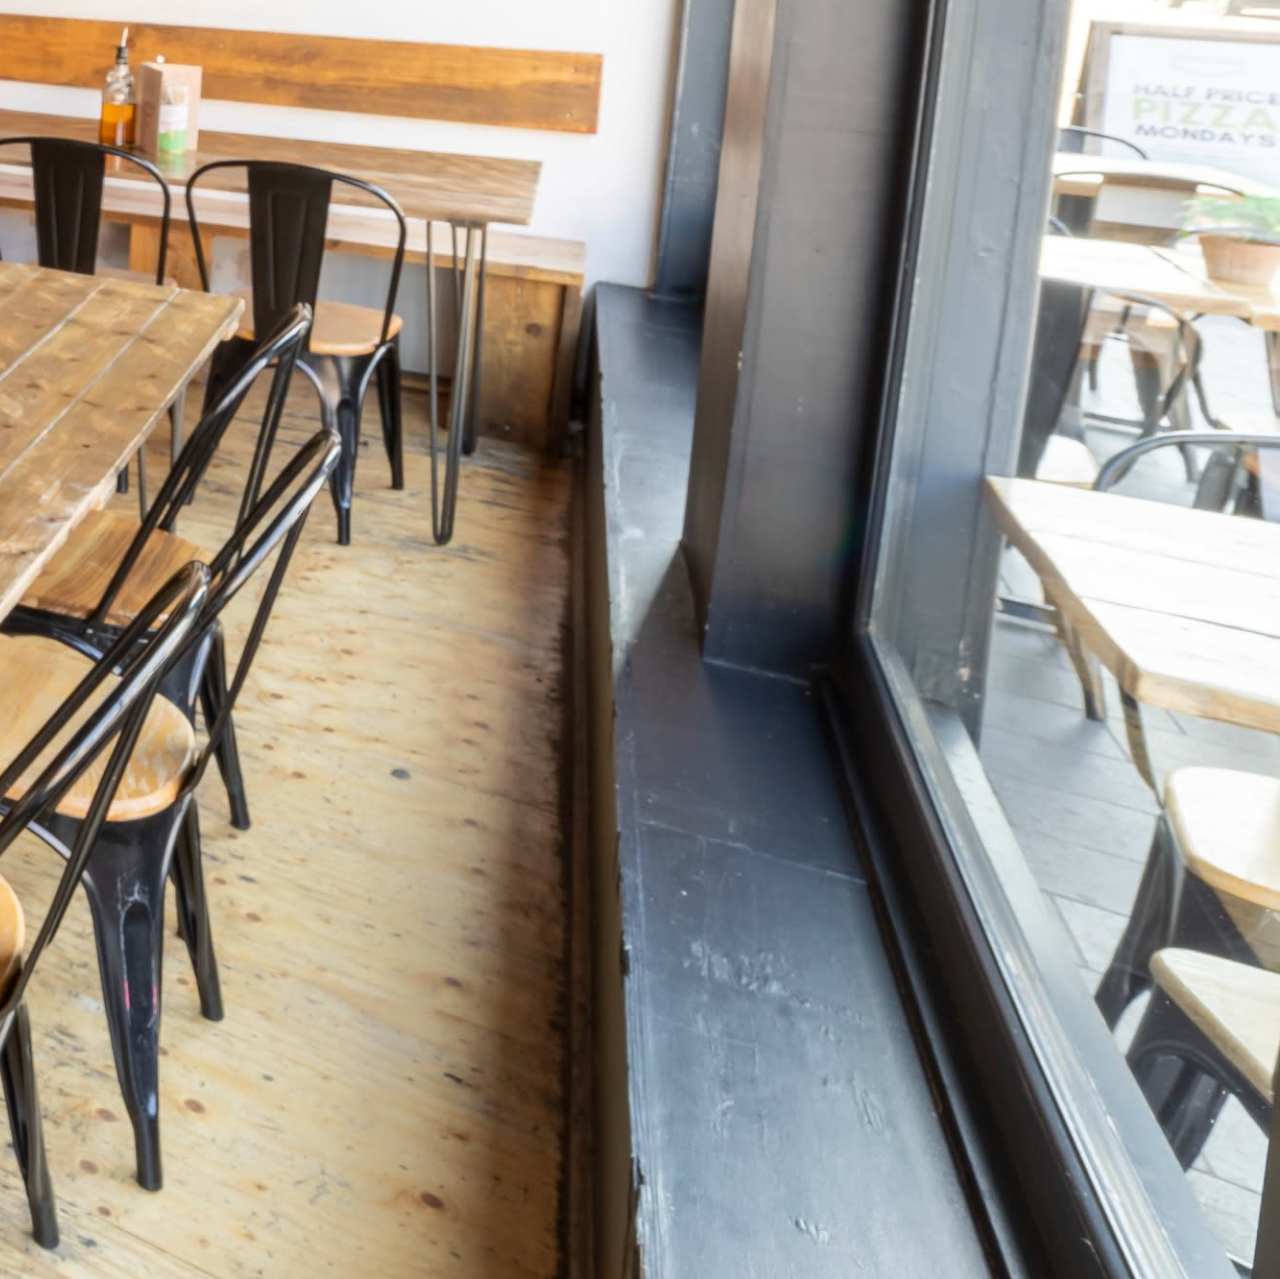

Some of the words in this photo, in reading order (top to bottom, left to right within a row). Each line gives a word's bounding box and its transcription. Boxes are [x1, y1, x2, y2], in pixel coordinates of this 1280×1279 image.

[1133, 82, 1195, 99] HALF
[1205, 87, 1280, 105] PRICE
[1133, 97, 1277, 131] PIZZA
[1135, 125, 1277, 148] MONDAYS
